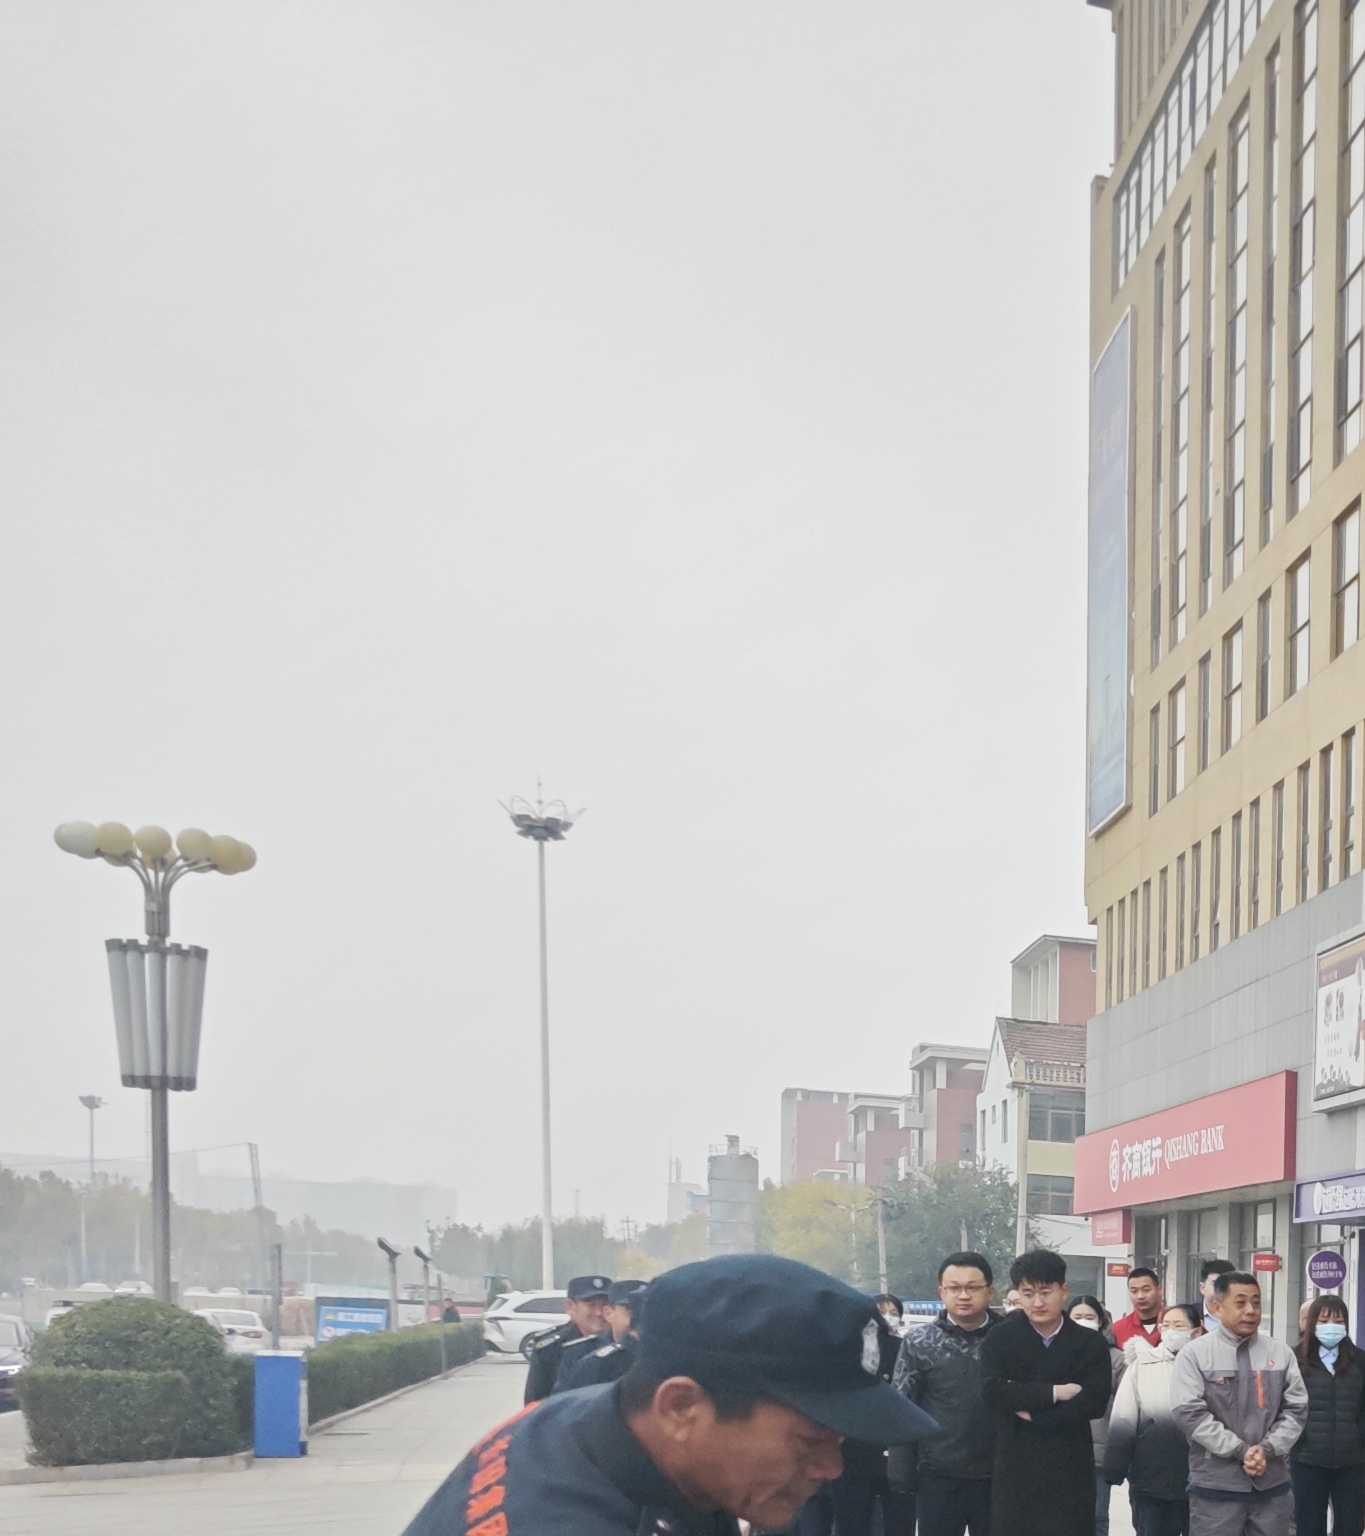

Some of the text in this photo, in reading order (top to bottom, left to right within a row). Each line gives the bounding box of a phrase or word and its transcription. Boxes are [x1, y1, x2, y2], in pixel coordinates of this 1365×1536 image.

[1121, 1125, 1225, 1182] 齐商银行 QISHANG BANK
